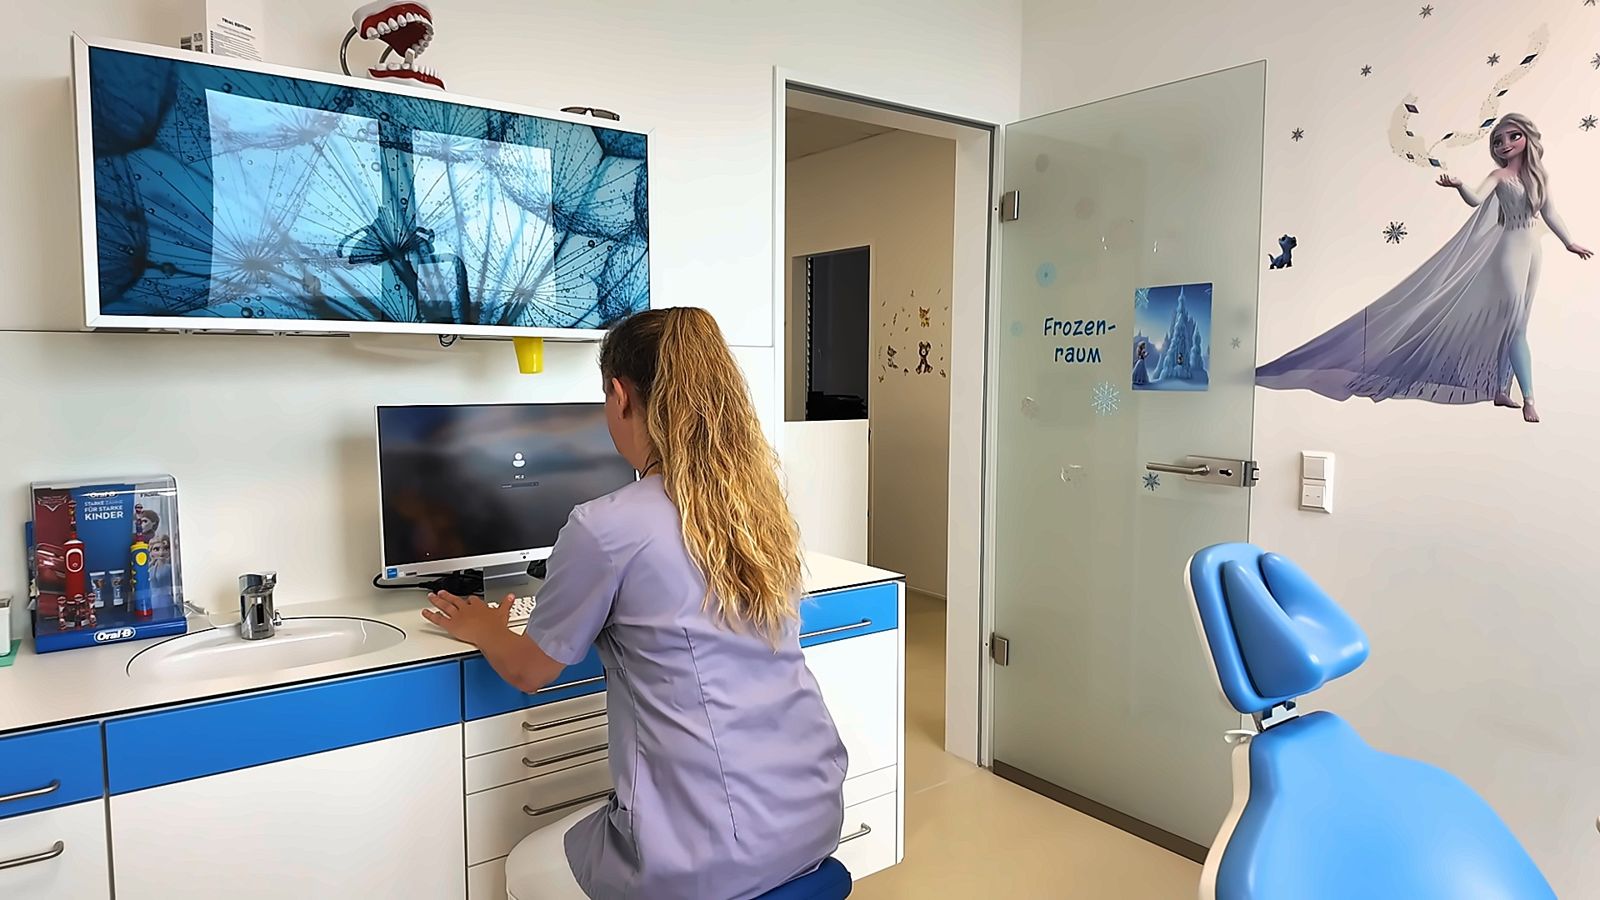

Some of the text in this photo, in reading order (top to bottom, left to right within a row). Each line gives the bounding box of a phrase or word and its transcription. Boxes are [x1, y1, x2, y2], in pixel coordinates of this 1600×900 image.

[1044, 317, 1116, 336] Frozen-
[1054, 347, 1102, 363] raum
[84, 511, 124, 521] KINDER
[96, 628, 132, 641] Oral-B
